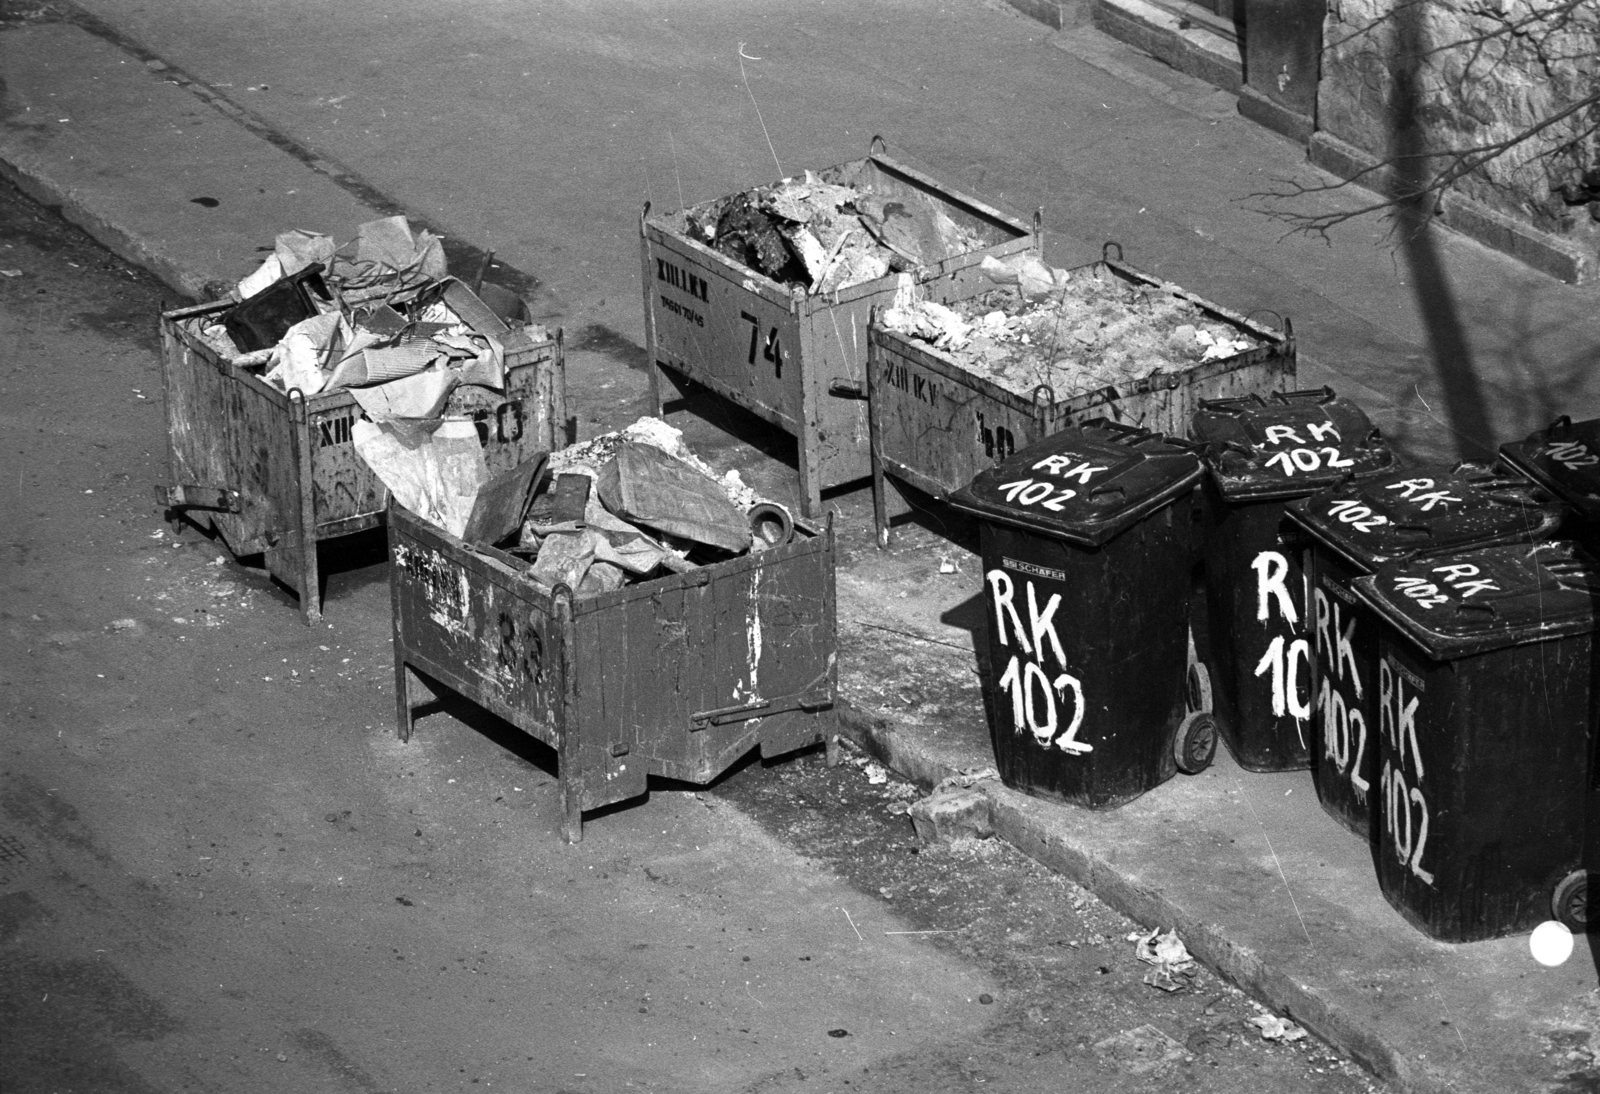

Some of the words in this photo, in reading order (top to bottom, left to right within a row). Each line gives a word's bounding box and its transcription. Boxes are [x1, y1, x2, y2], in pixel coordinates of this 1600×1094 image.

[741, 310, 783, 379] 74
[1266, 420, 1341, 445] RK
[1032, 455, 1108, 484] RK
[1265, 448, 1354, 476] 102
[1545, 440, 1600, 470] 102
[998, 478, 1077, 512] 102
[1385, 477, 1462, 511] RK
[1326, 500, 1388, 532] 102
[1394, 576, 1449, 609] 102
[1432, 563, 1500, 597] RK
[986, 570, 1066, 671] RK
[1315, 587, 1364, 701] RK
[999, 655, 1094, 755] 102
[1380, 658, 1424, 782] RK
[1317, 674, 1370, 793] 102
[1381, 758, 1435, 886] 102
